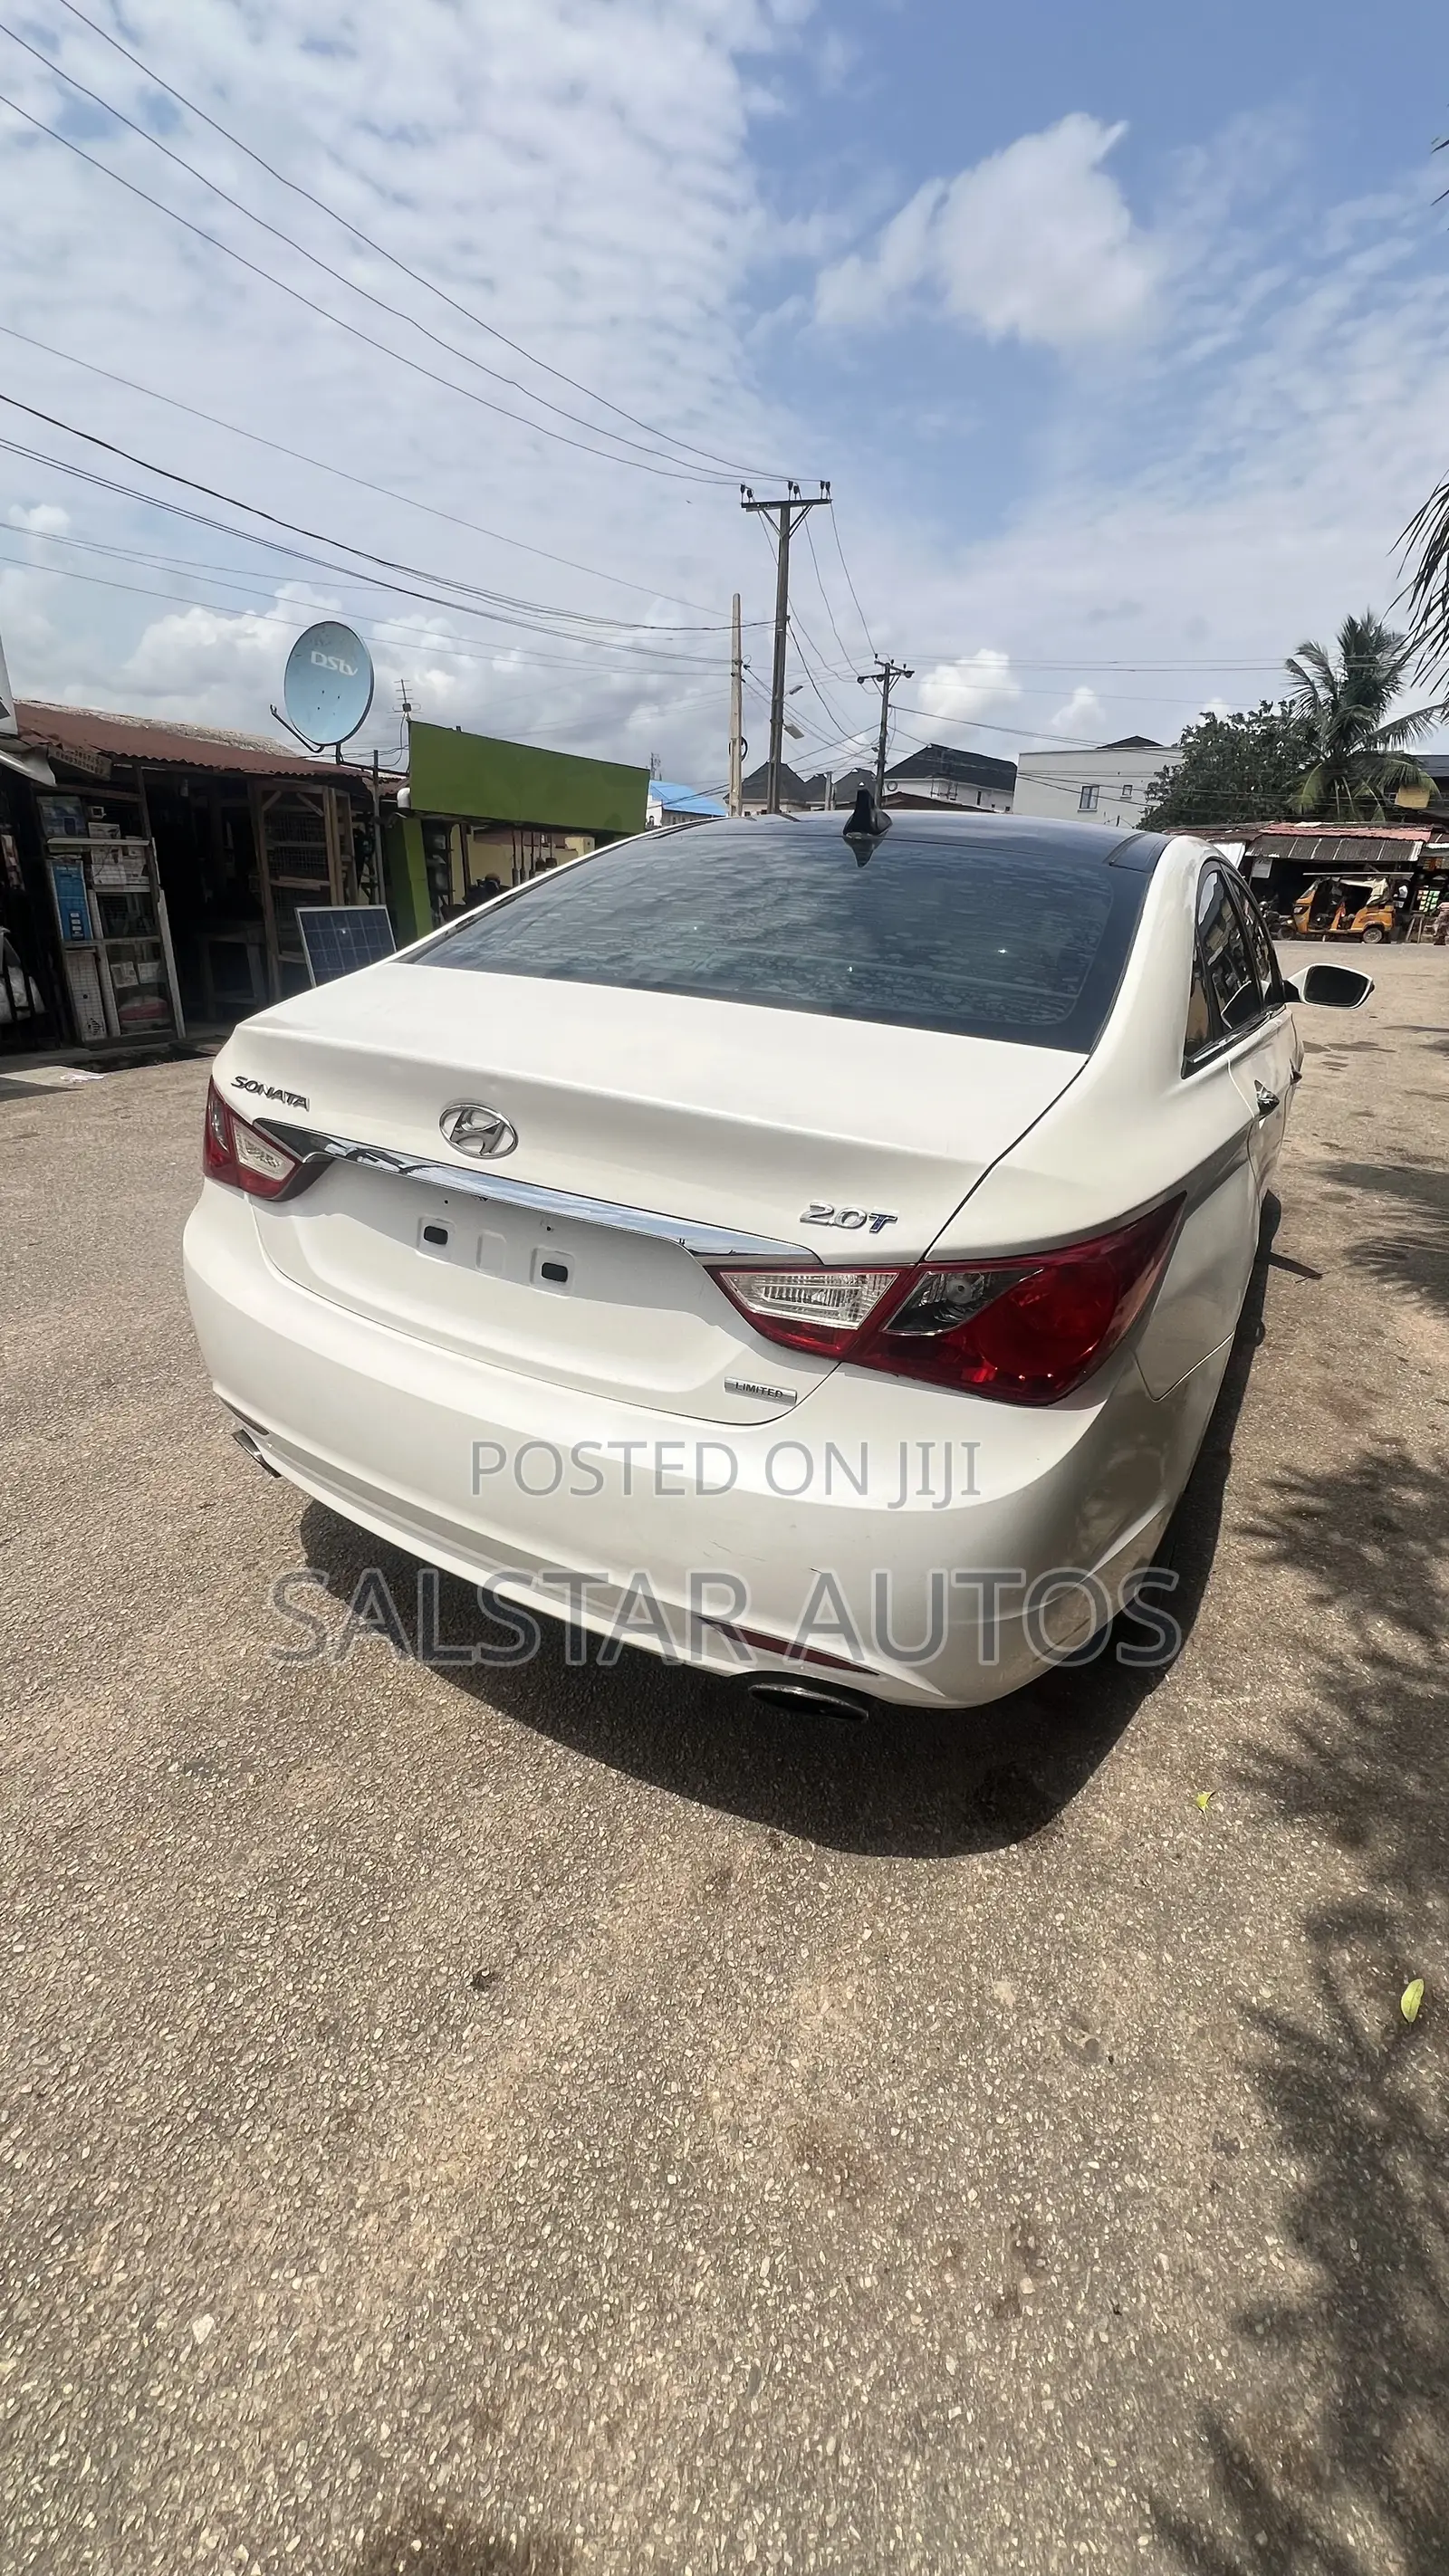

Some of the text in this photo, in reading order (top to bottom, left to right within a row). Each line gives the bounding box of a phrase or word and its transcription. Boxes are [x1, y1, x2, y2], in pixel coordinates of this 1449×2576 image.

[311, 650, 358, 676] DStv
[230, 1076, 310, 1112] SONATA
[735, 1382, 783, 1398] LIMITED
